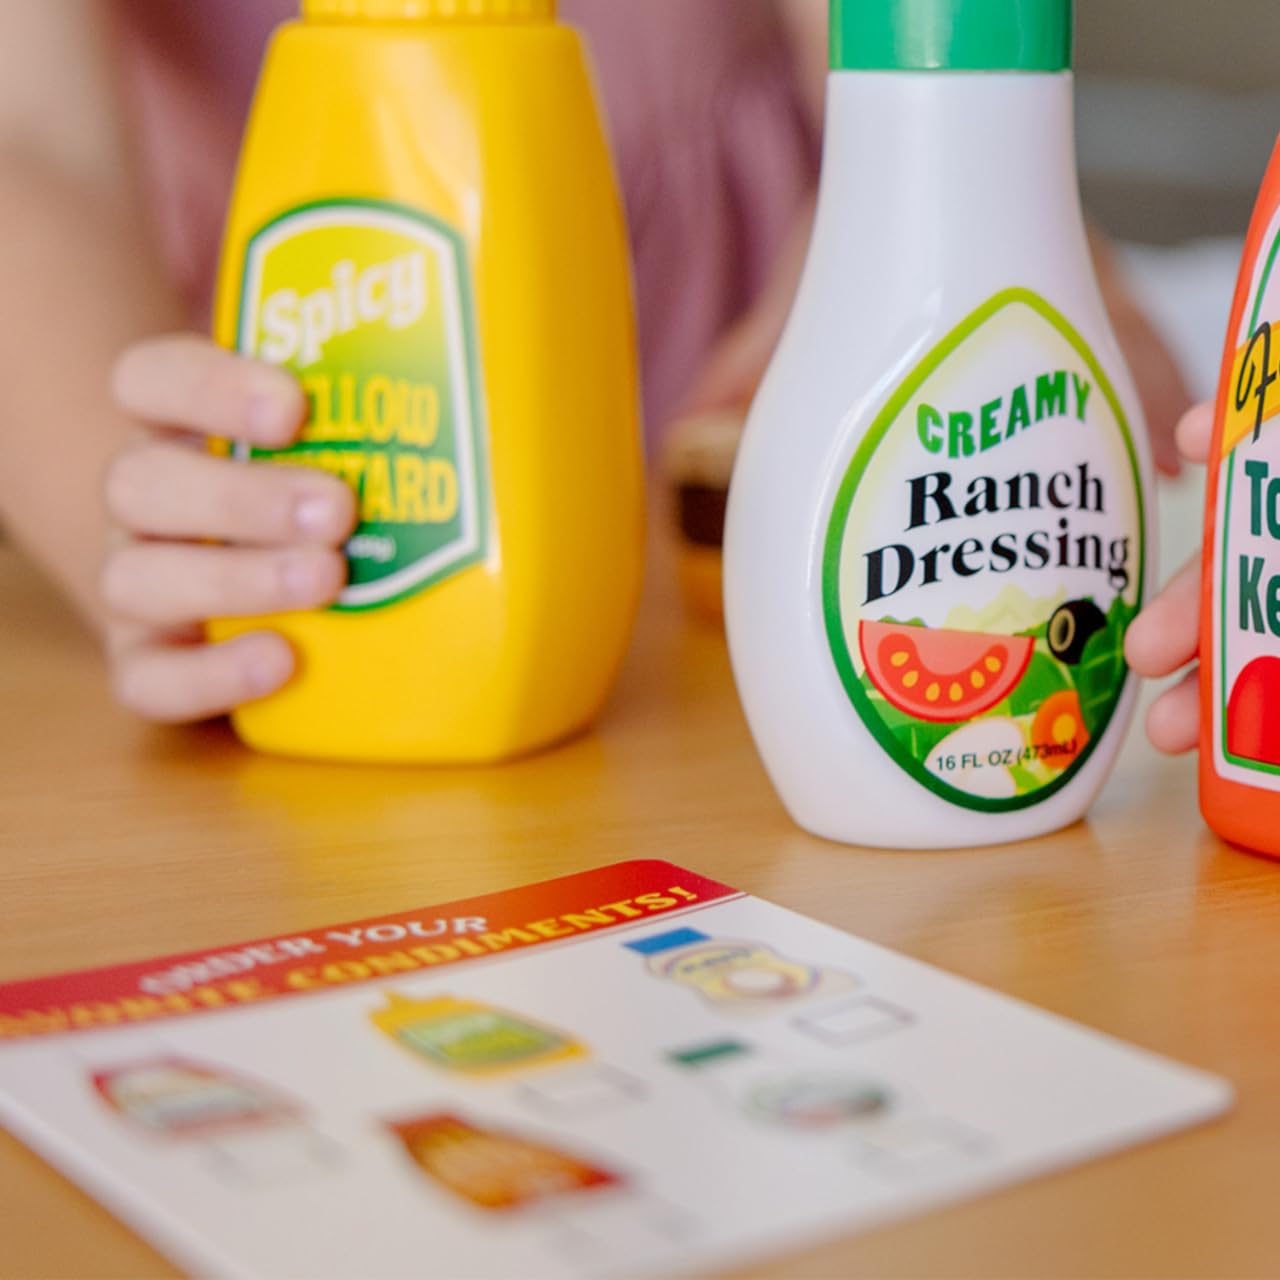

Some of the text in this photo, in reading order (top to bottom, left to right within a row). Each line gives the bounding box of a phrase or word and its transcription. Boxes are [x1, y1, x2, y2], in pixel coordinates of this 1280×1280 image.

[261, 250, 427, 367] Spicy
[302, 373, 440, 447] LLOW
[916, 370, 1092, 459] CREAMY
[903, 461, 1108, 533] Ranch
[860, 517, 1132, 607] Dressing
[936, 754, 956, 771] 16
[961, 752, 983, 769] FL
[988, 749, 1013, 766] OZ
[286, 885, 699, 989] CONDIMENTS!
[326, 916, 489, 947] YOUR
